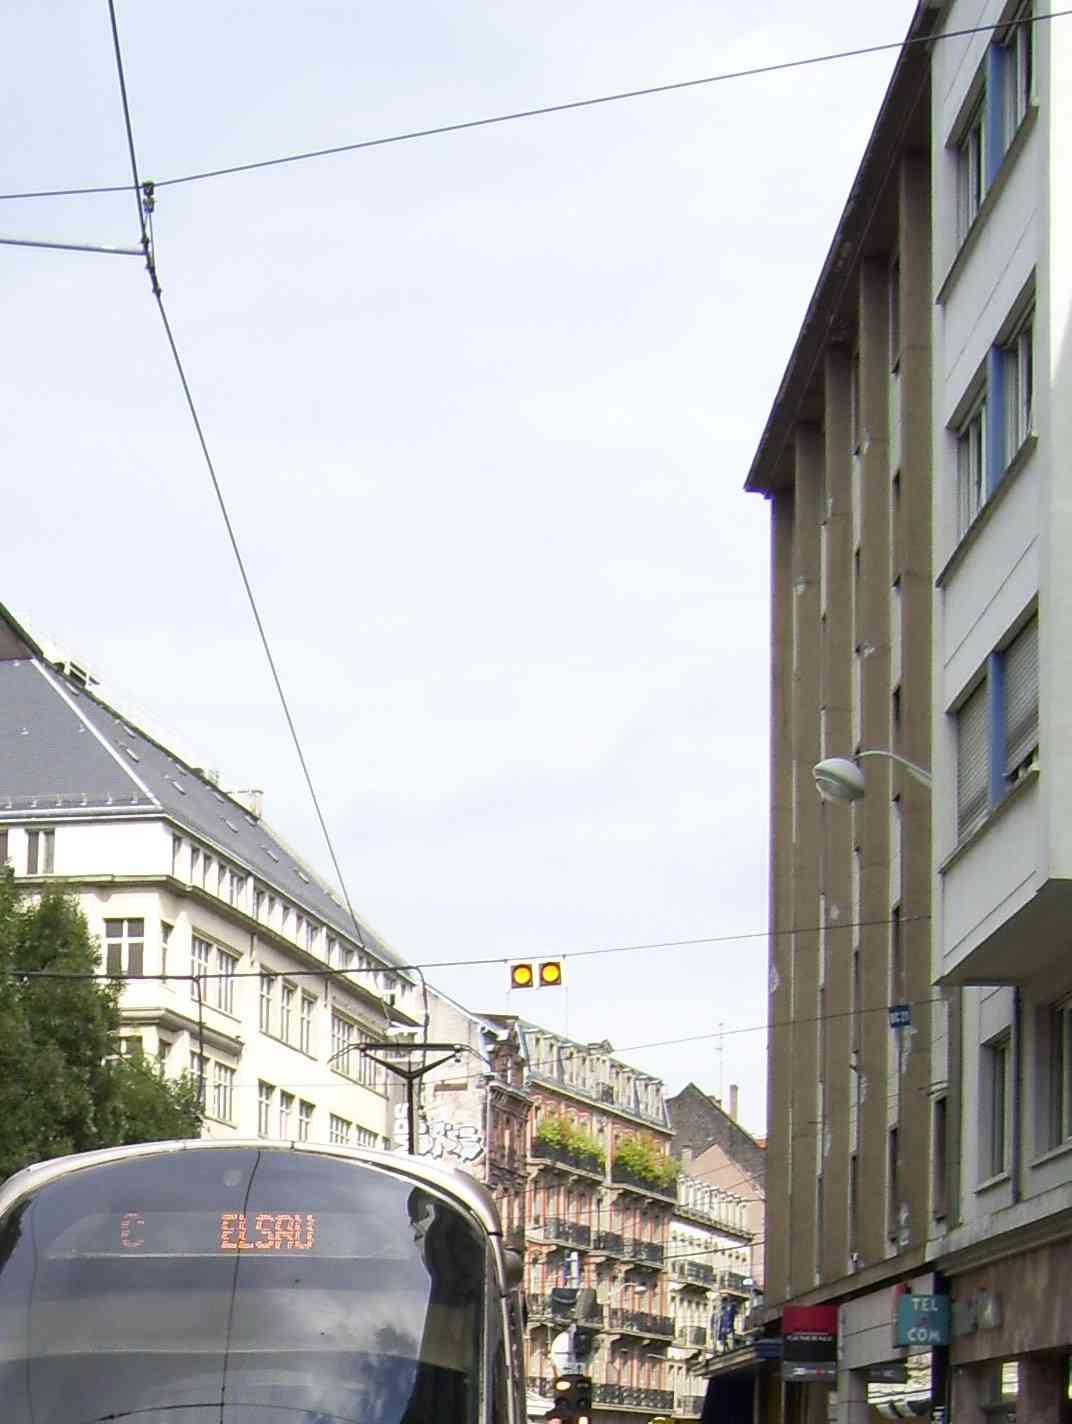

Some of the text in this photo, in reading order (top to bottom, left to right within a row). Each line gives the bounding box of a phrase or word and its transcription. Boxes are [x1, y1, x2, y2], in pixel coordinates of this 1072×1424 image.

[120, 1213, 316, 1249] C ELSAU
[912, 1298, 939, 1312] TEL
[907, 1328, 941, 1342] COM
